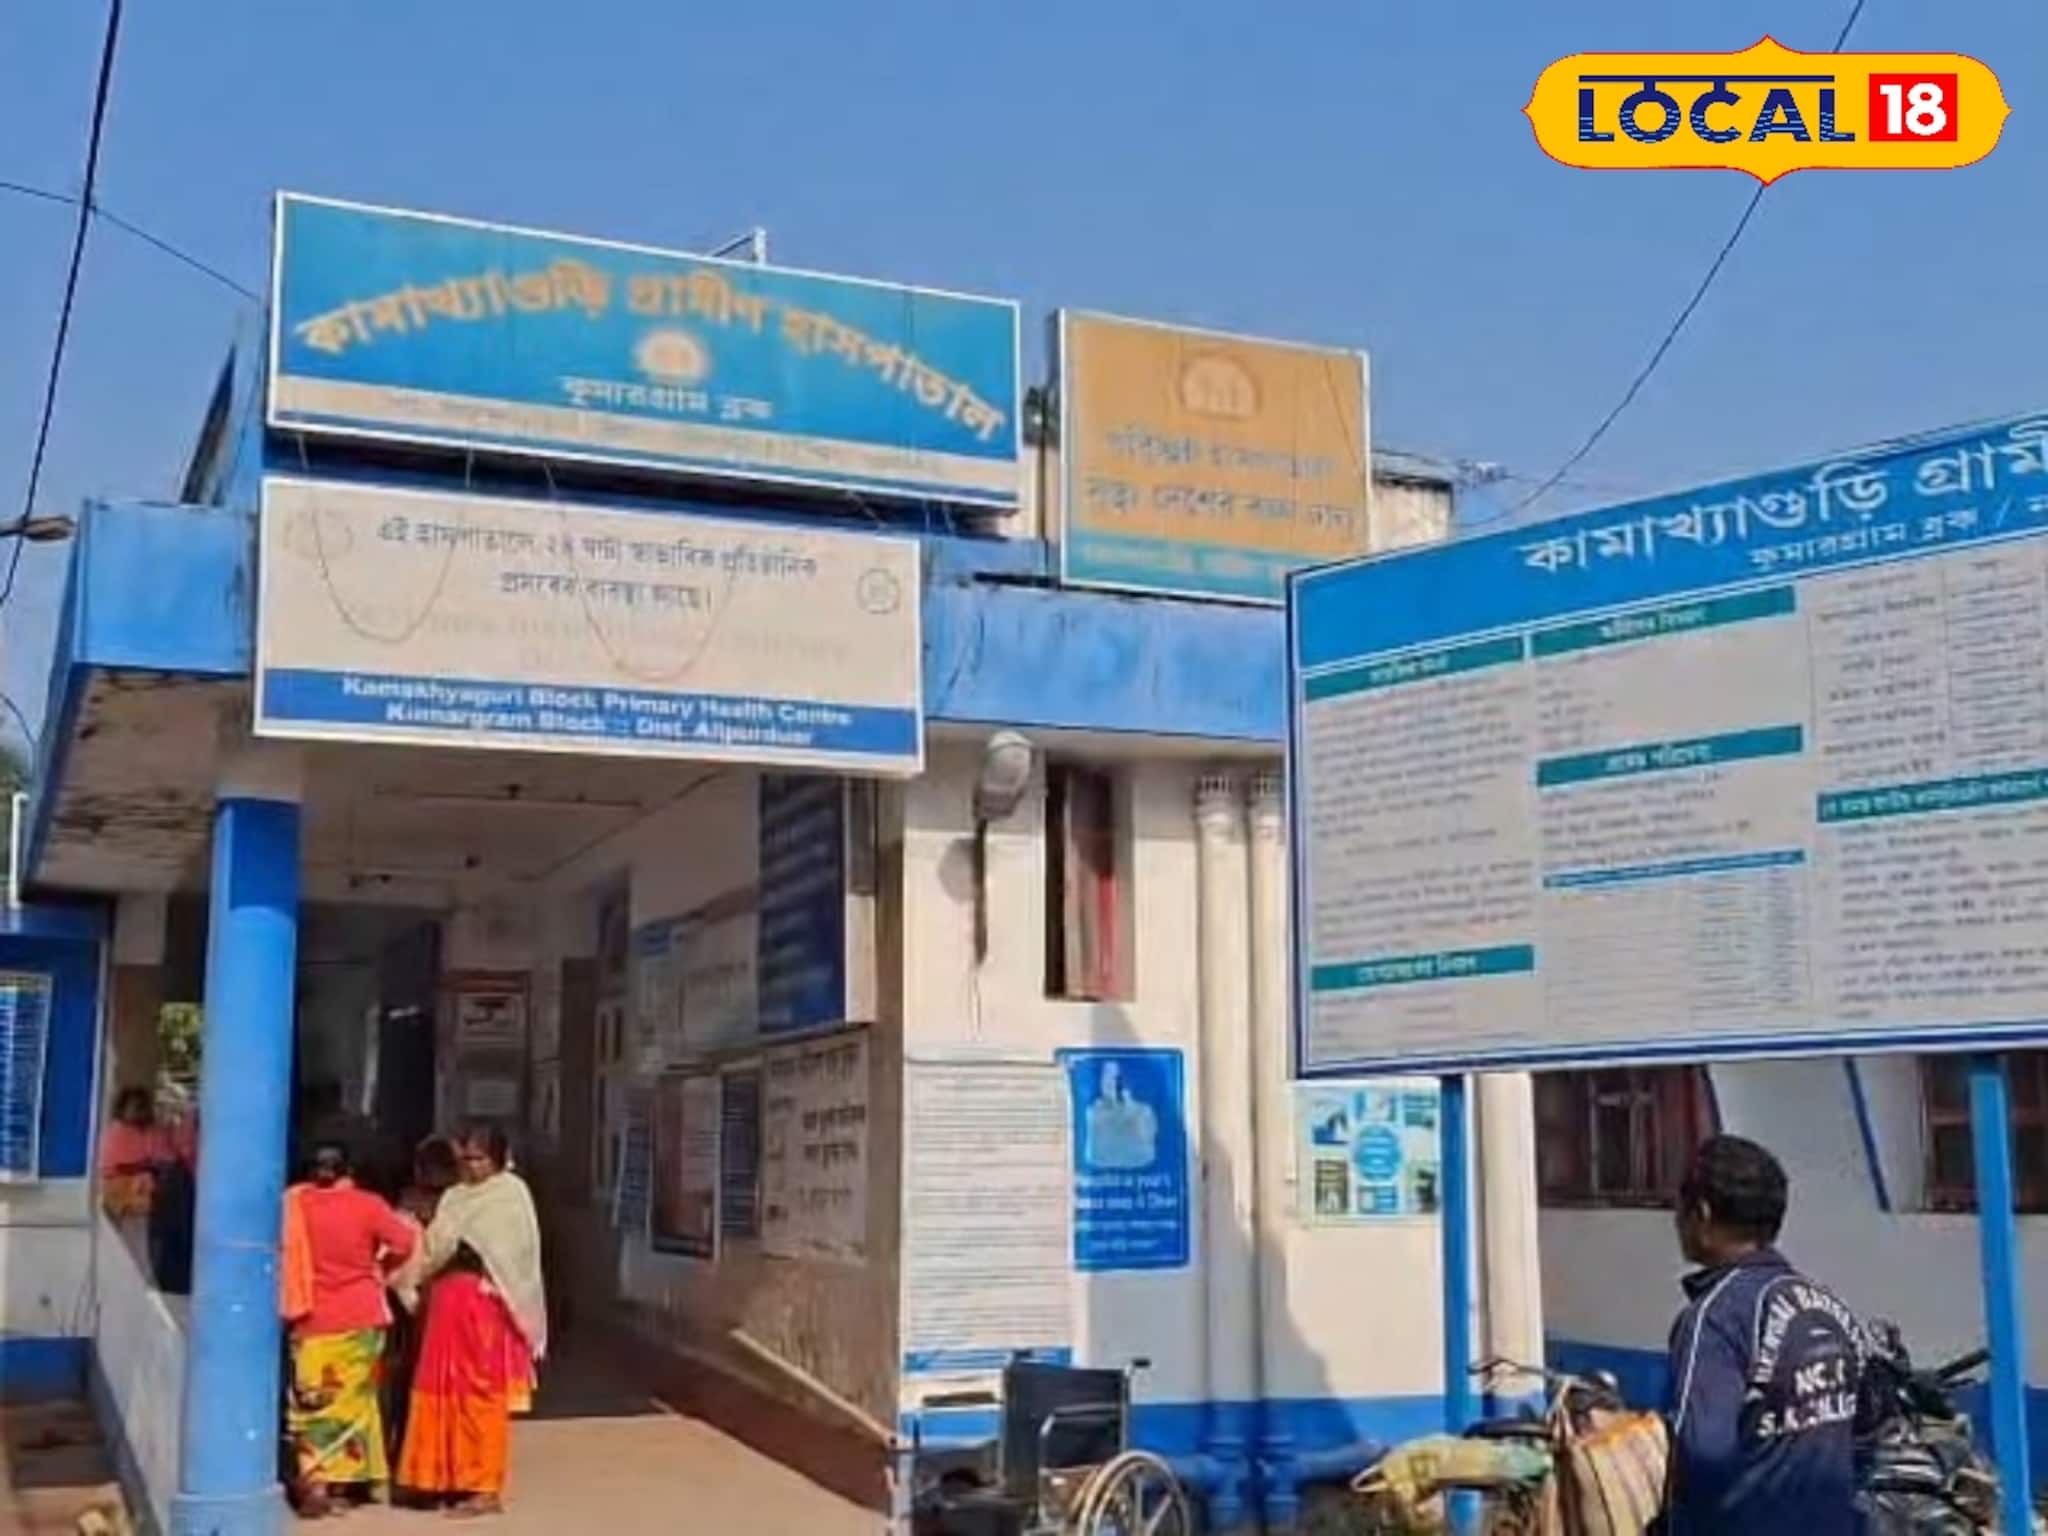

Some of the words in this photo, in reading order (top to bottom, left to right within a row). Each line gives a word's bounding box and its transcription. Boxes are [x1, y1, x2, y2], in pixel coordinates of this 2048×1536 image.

[780, 303, 1005, 440] হাসপাতাল
[1521, 460, 1889, 576] কামাখ্যাগুড়ি
[529, 686, 599, 709] Block
[604, 689, 694, 719] Primary
[700, 696, 774, 720] Health
[777, 702, 853, 727] Centre
[538, 709, 606, 733] Block
